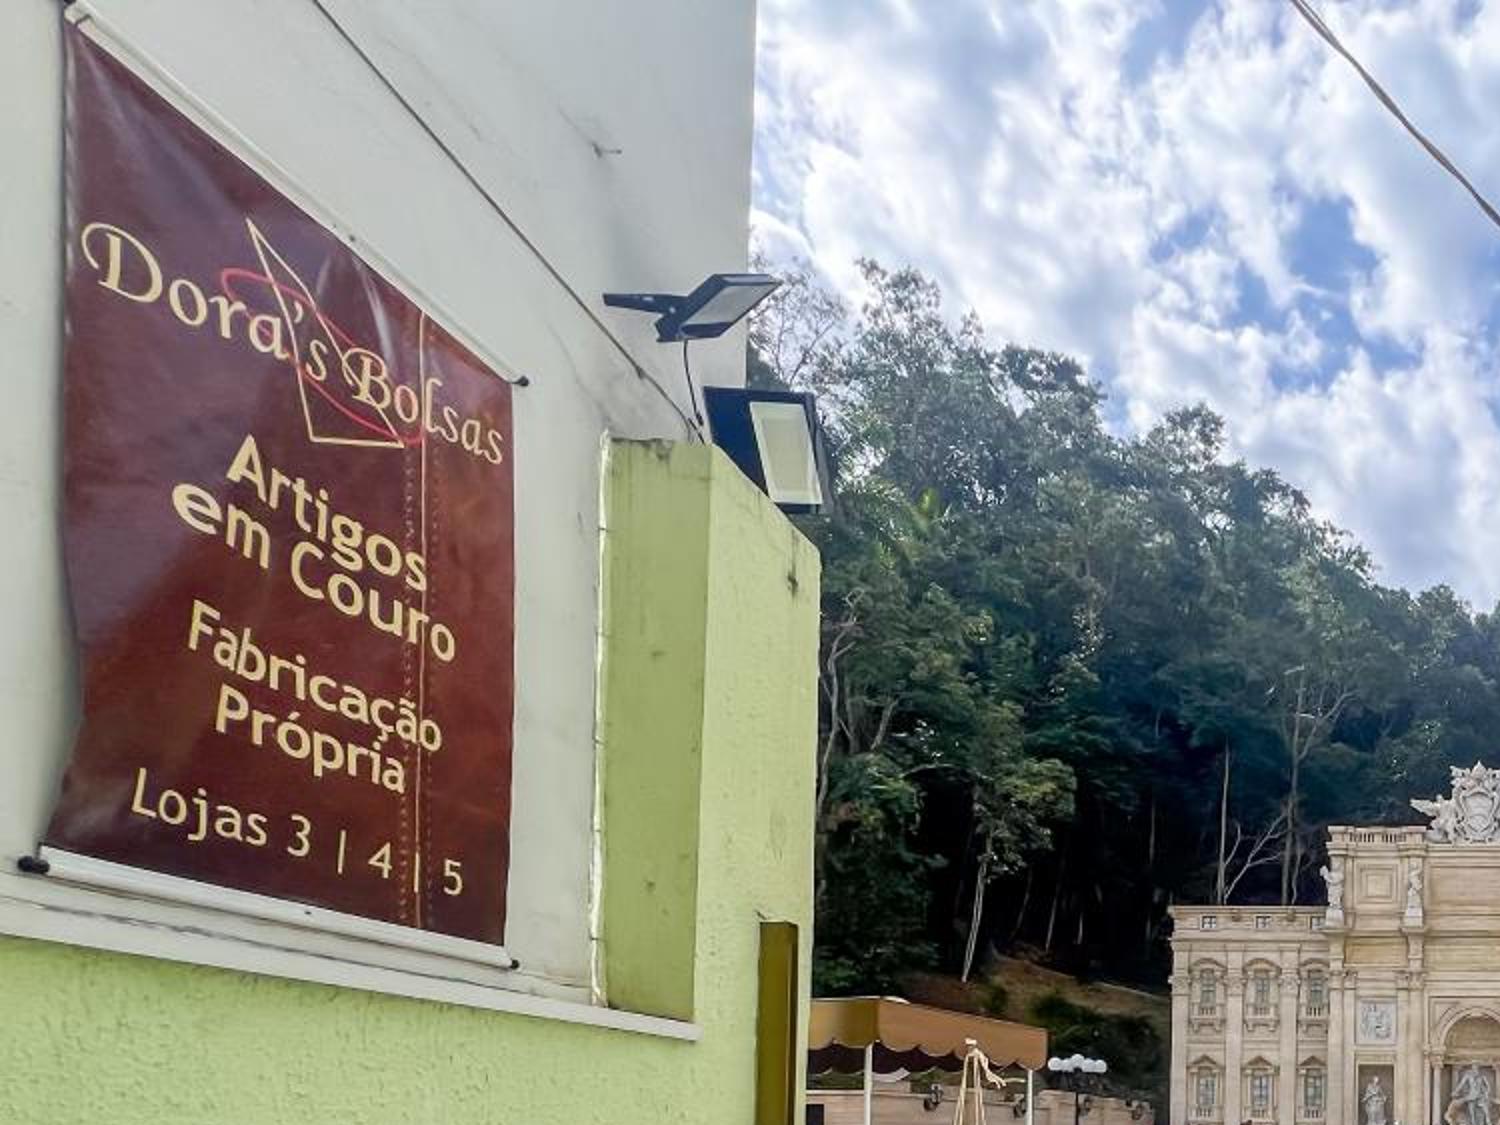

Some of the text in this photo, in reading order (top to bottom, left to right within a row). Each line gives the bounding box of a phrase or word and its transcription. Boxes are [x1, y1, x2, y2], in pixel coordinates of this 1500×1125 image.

[81, 222, 503, 465] Dora's Bolsas
[172, 483, 456, 663] em Couro
[226, 434, 427, 592] Artigos
[187, 599, 442, 753] Fabricação
[214, 680, 405, 794] Própria
[131, 767, 268, 846] Lojas
[287, 814, 312, 857] 3
[367, 842, 393, 879] 4
[443, 859, 463, 896] 5
